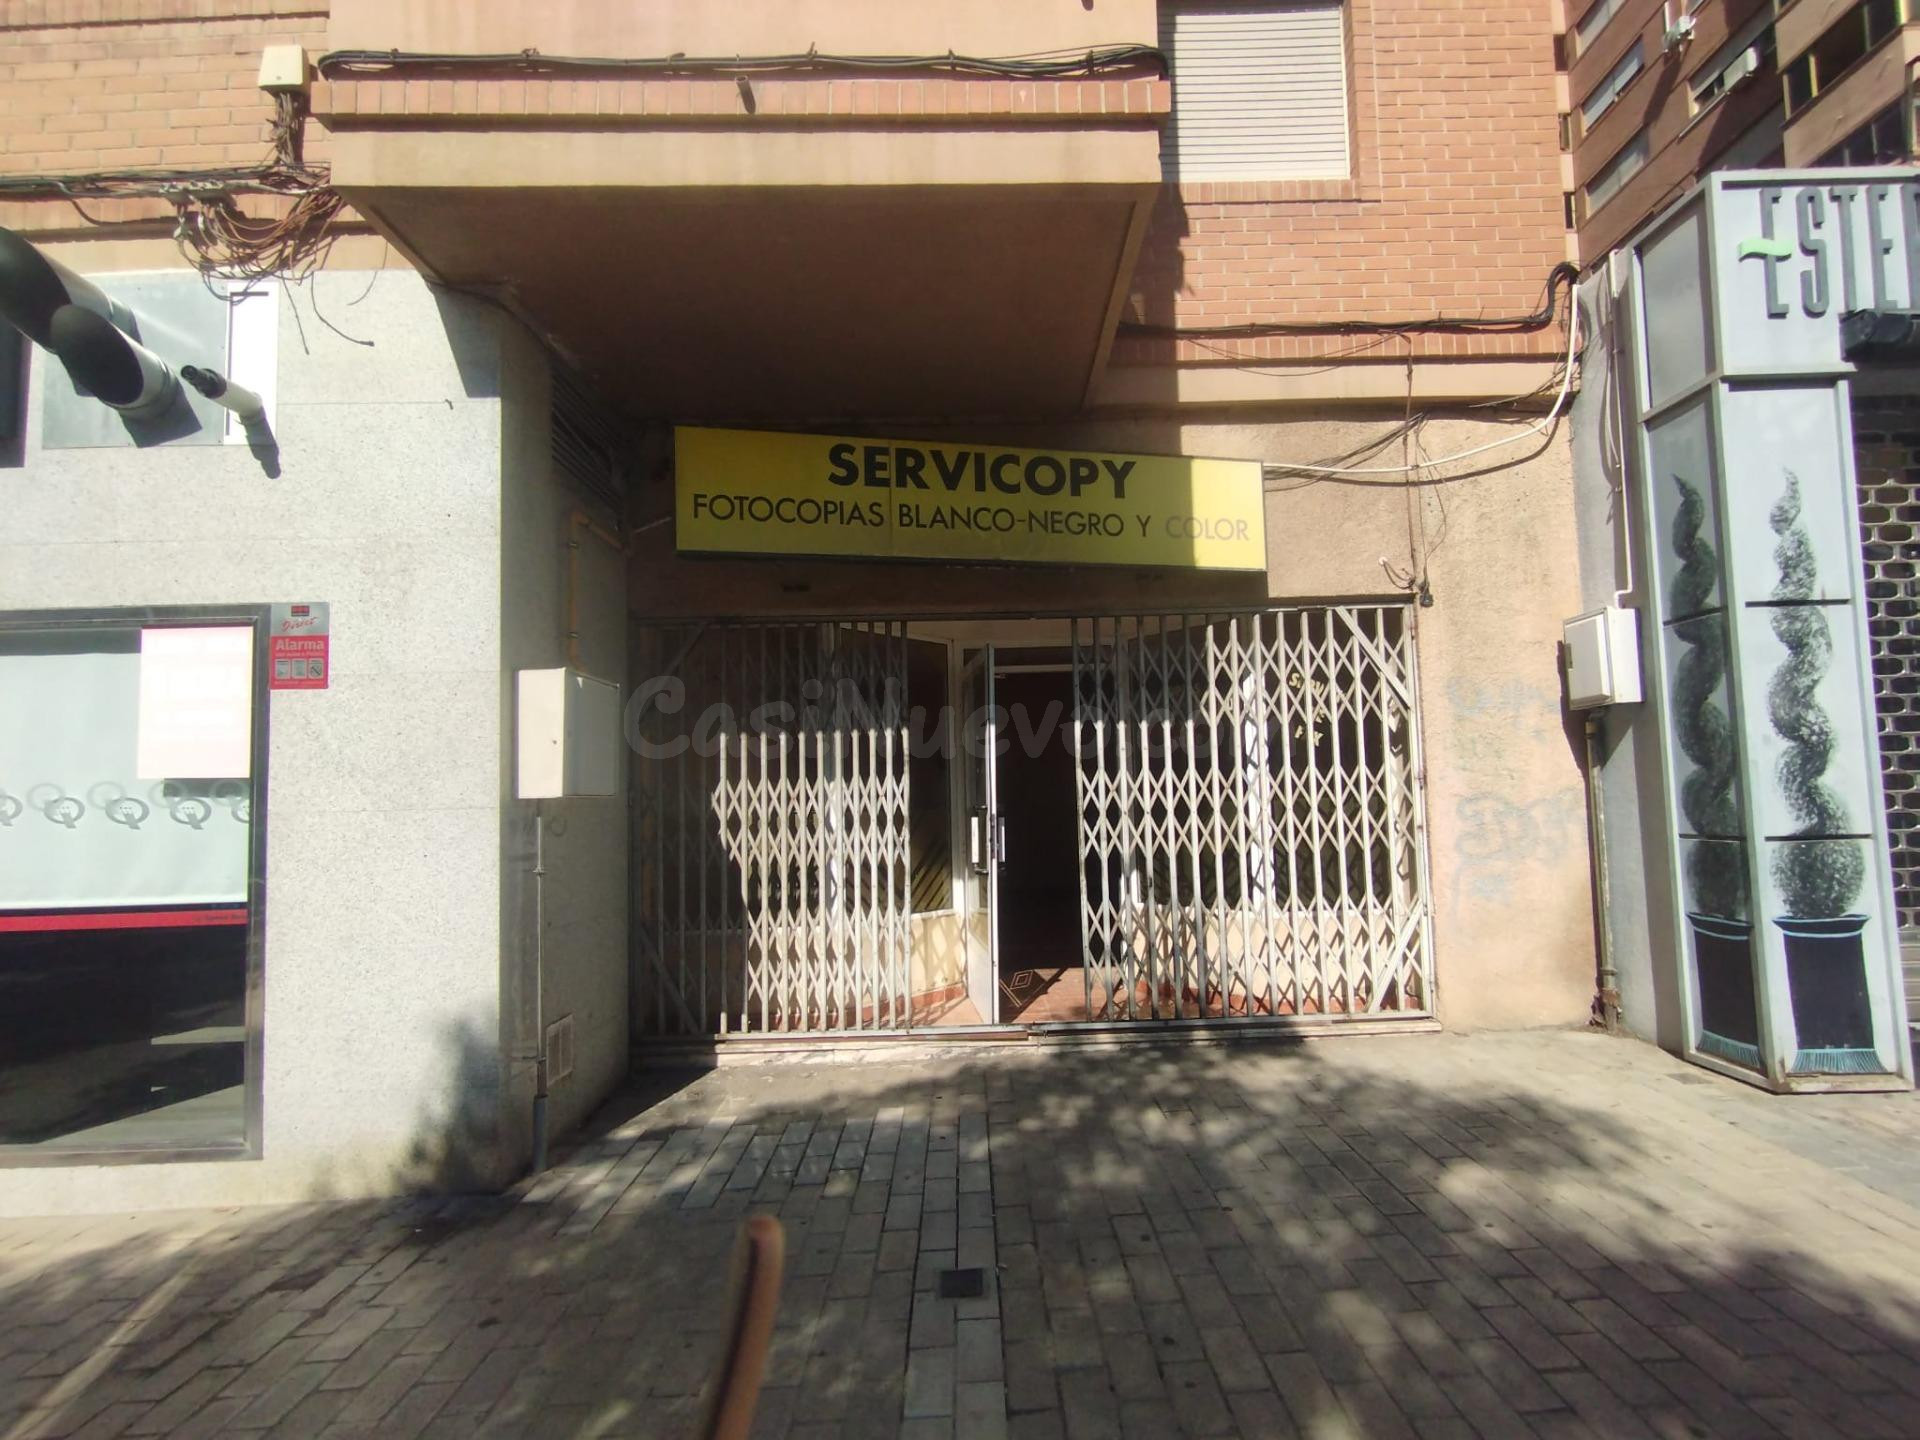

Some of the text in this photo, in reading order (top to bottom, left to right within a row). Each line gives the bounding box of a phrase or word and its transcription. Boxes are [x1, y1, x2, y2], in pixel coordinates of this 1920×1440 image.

[828, 443, 1136, 499] SERVICOPY
[693, 493, 1249, 541] FOTOCOPIAS BLANCO-NEGRO Y COLOR
[276, 639, 324, 651] Alarma
